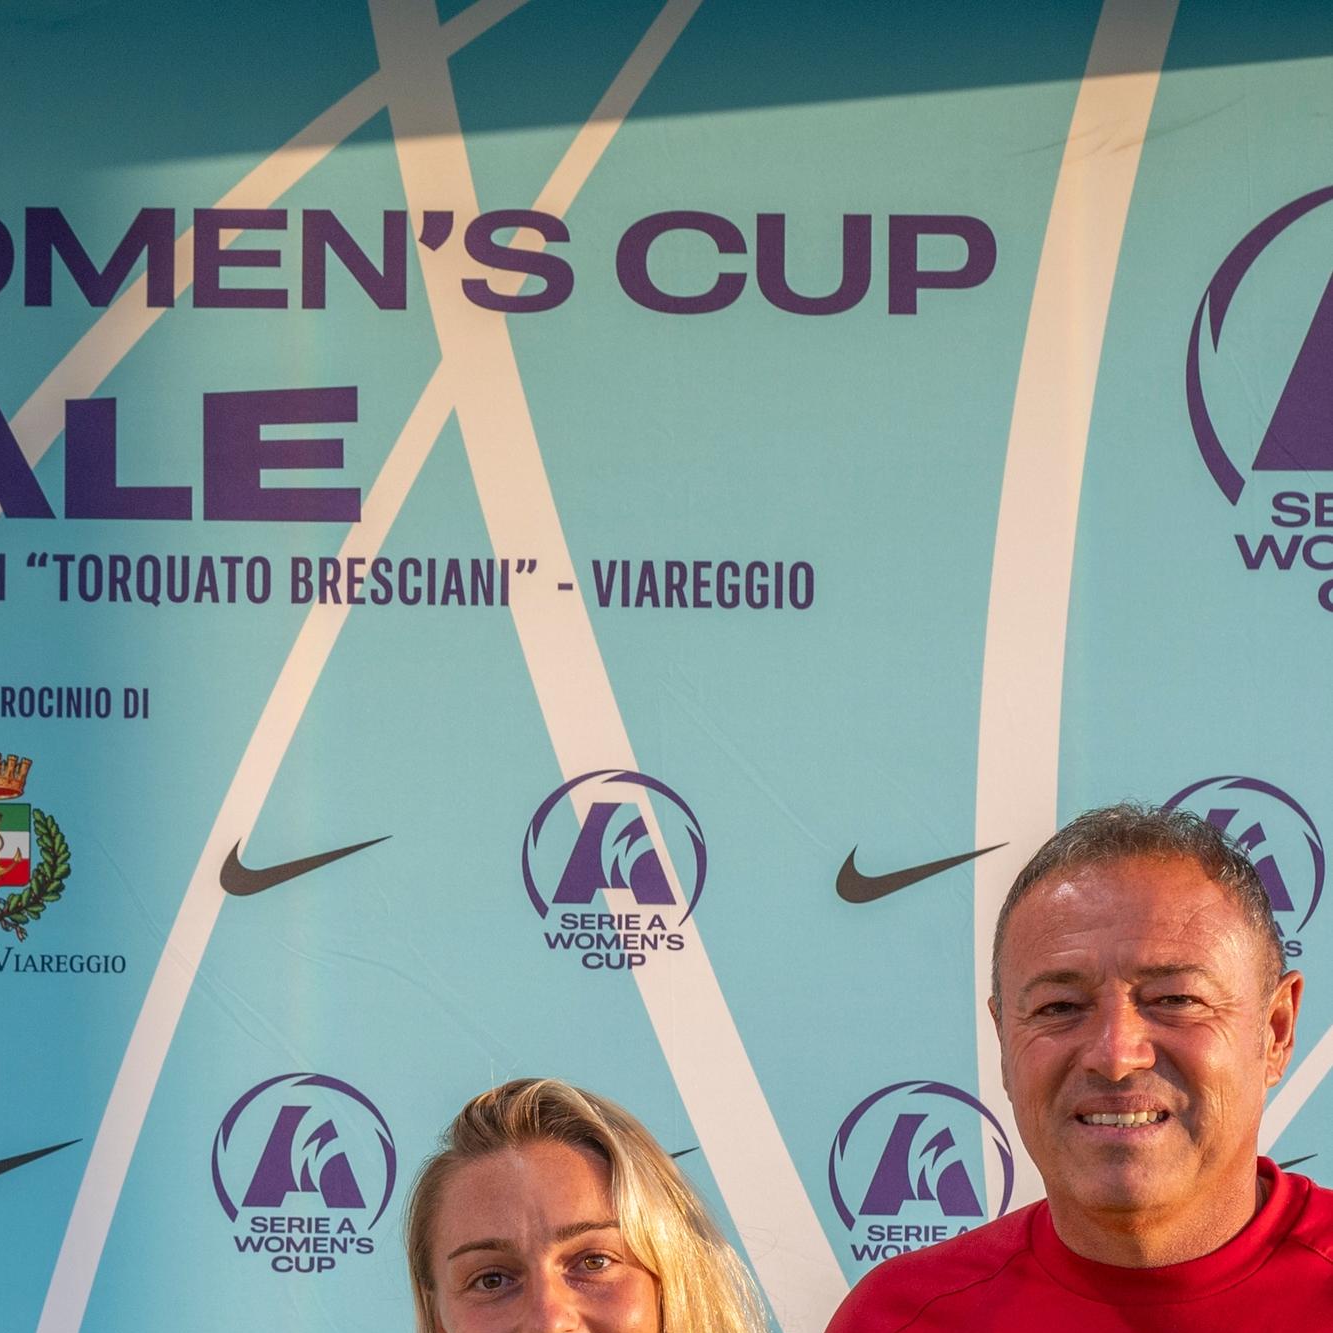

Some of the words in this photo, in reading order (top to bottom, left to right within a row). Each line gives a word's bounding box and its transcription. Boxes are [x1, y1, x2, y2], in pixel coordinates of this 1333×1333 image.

[616, 210, 996, 316] CUP
[27, 552, 270, 607] “TORQUATO
[291, 556, 536, 607] BRESCIANI”
[592, 559, 813, 610] VIAREGGIO
[123, 687, 149, 719] DI
[560, 913, 641, 930] SERIE
[647, 914, 667, 931] A
[544, 932, 685, 951] WOMEN'S
[581, 952, 646, 970] CUP
[250, 1216, 330, 1234] SERIE
[336, 1217, 357, 1235] A
[867, 1224, 947, 1242] SERIE
[233, 1235, 374, 1255] WOMEN'S
[271, 1256, 336, 1273] CUP
